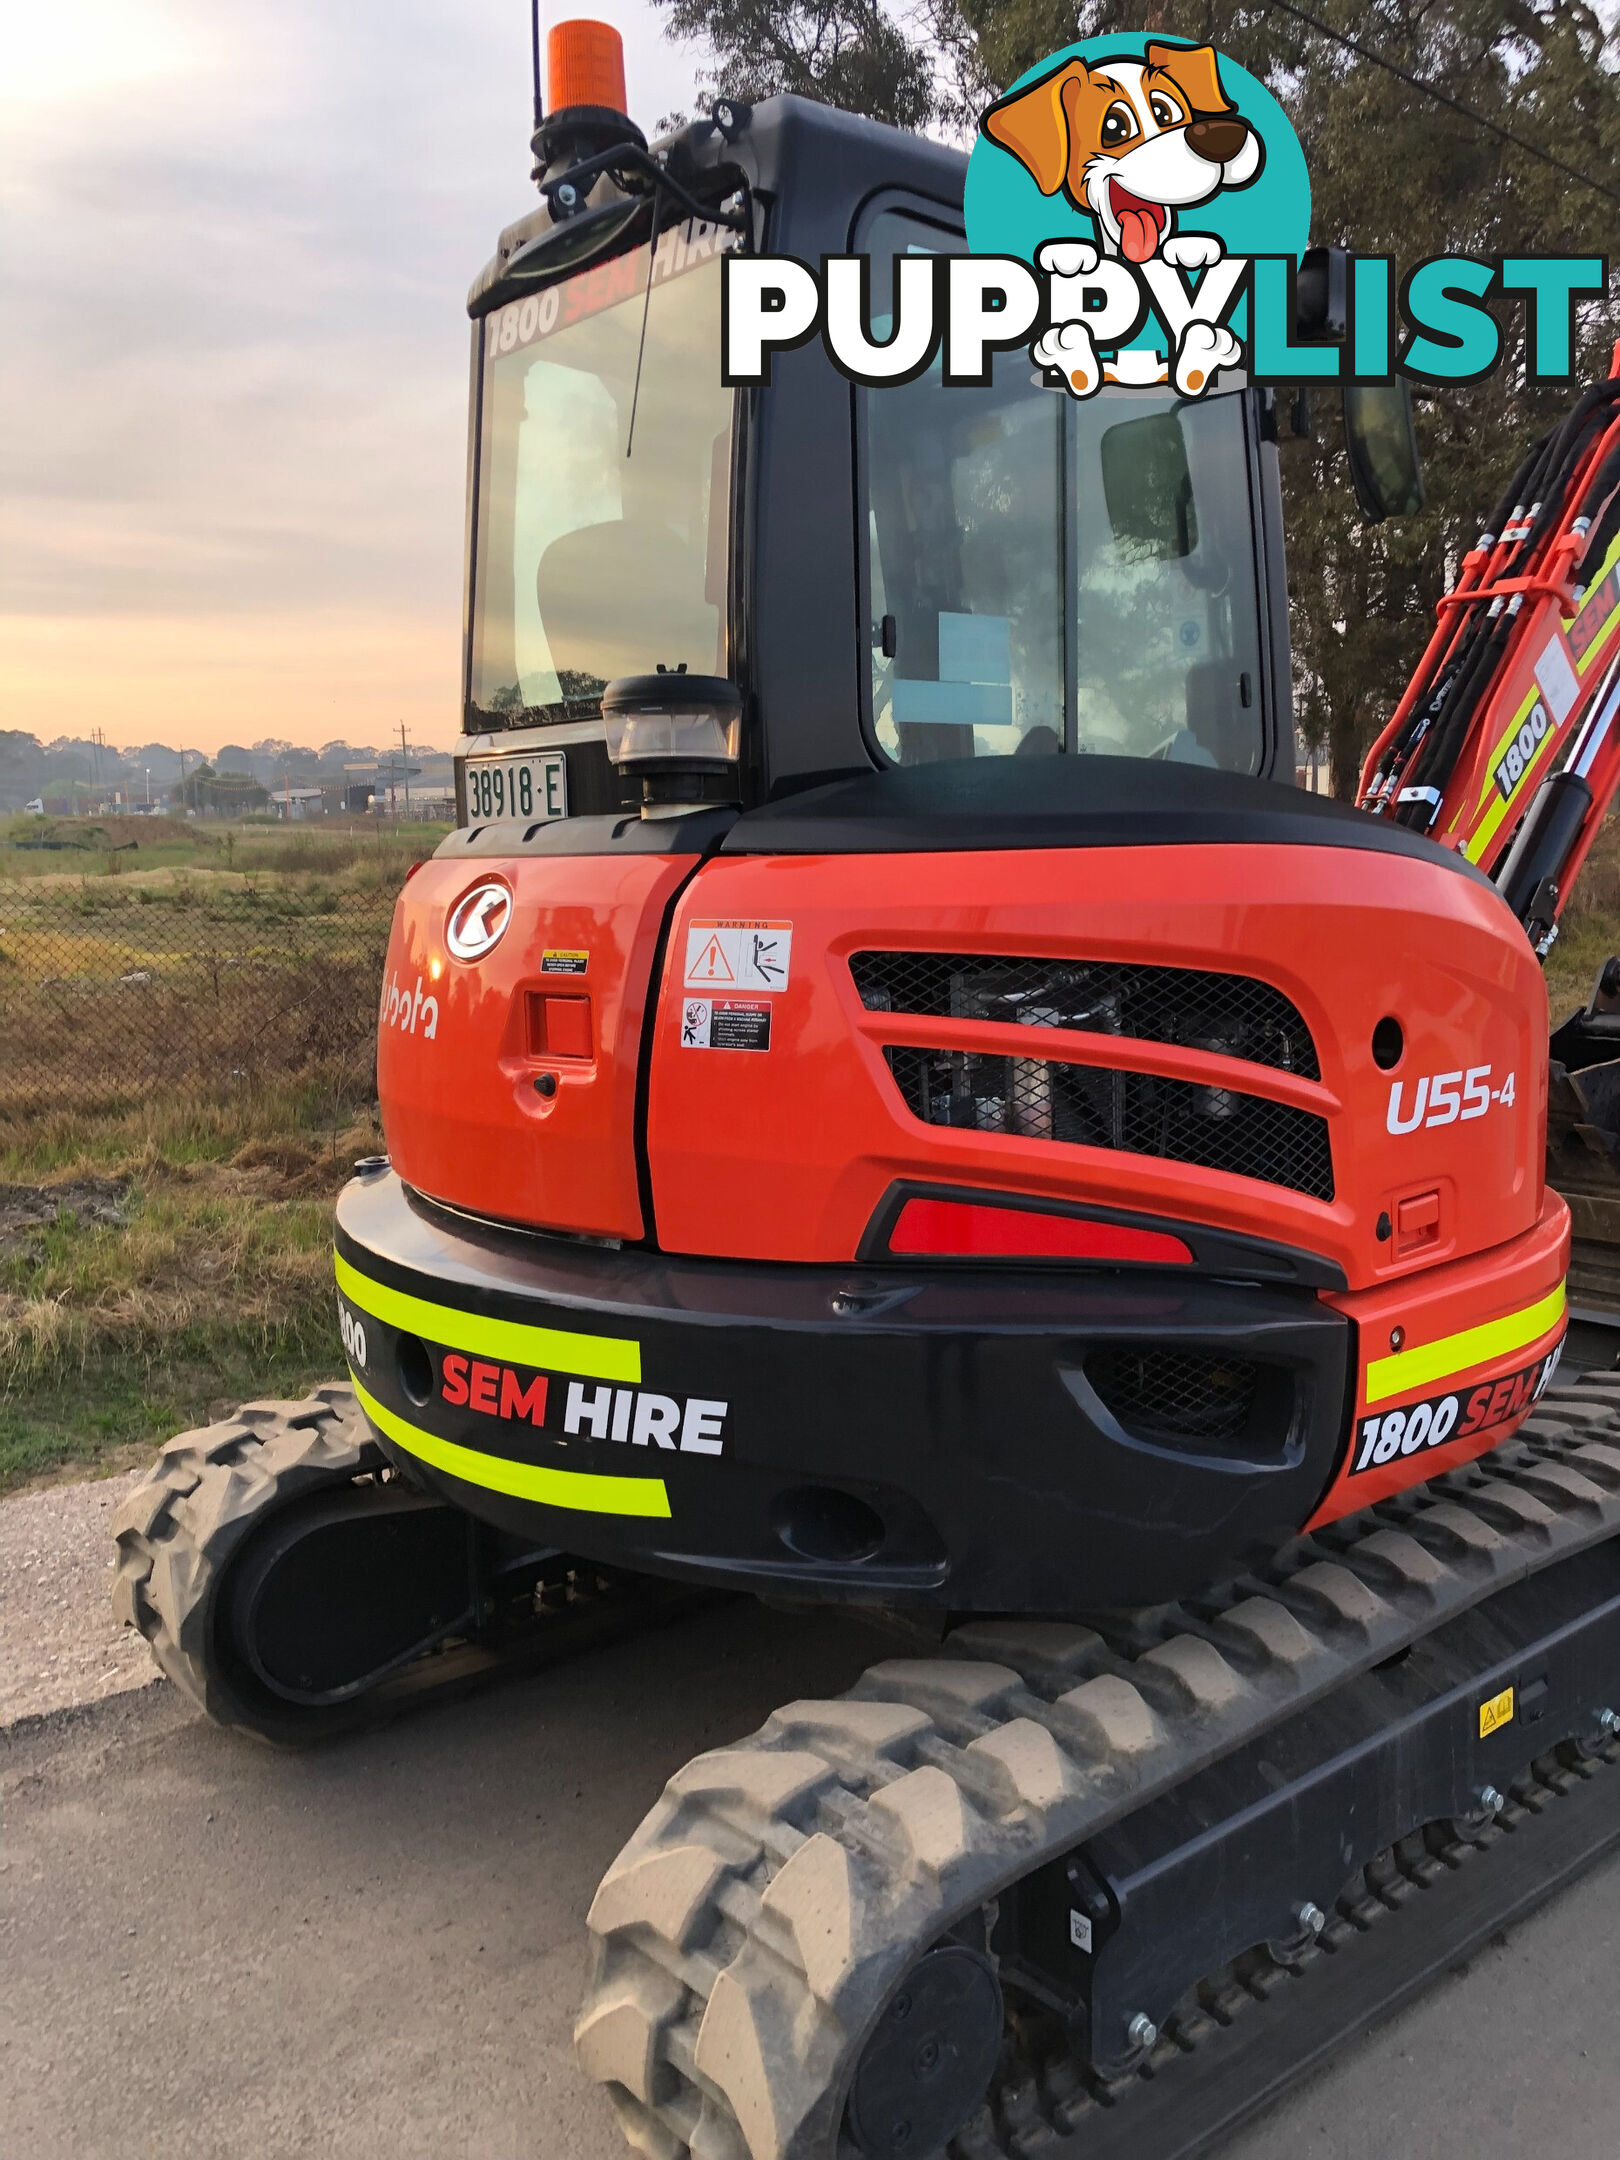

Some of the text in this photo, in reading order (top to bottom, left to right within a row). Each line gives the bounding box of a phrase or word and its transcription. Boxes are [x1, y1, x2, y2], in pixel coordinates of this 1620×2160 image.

[488, 287, 560, 357] 1800
[564, 245, 640, 321] SEM
[1496, 576, 1615, 796] 1800 SEM
[716, 921, 769, 929] WARNING
[733, 1002, 759, 1010] DANGER
[1386, 1064, 1515, 1135] U55-4
[442, 1354, 549, 1428] SEM
[564, 1381, 729, 1456] HIRE
[1356, 1395, 1459, 1471] 1800
[1457, 1365, 1540, 1436] SEM
